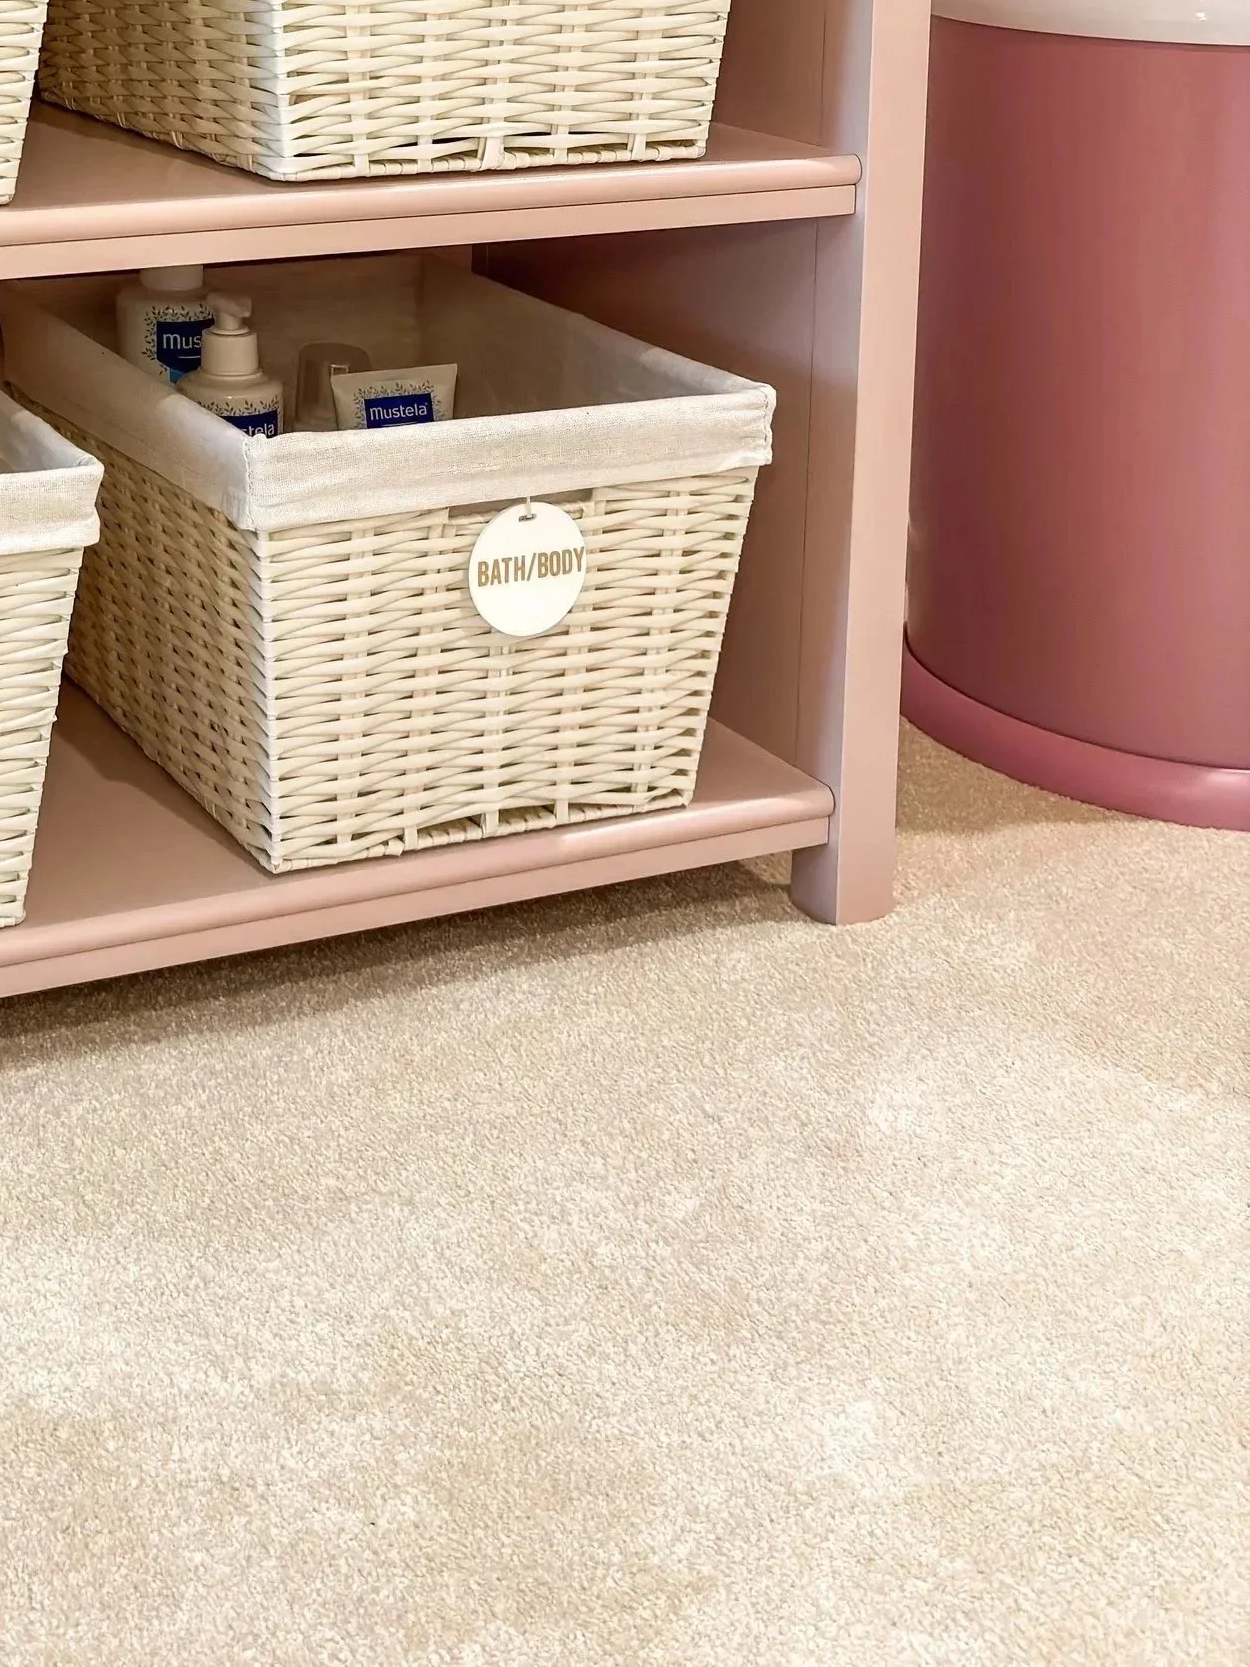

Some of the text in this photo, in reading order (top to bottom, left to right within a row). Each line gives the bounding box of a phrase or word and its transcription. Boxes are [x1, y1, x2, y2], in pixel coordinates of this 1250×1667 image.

[162, 333, 202, 350] mus
[369, 403, 428, 421] mustela
[477, 546, 586, 588] BATH/BODY
